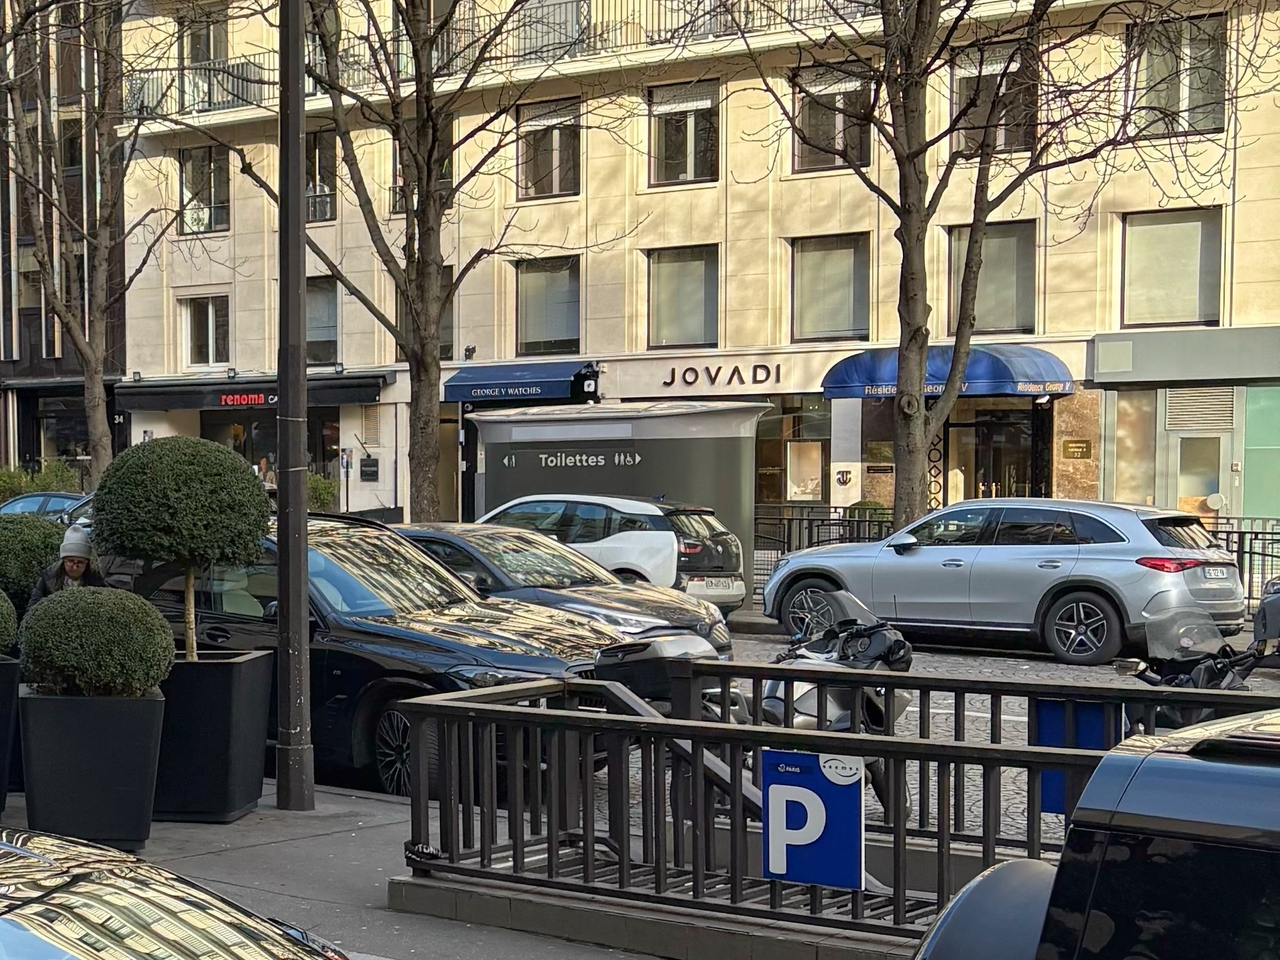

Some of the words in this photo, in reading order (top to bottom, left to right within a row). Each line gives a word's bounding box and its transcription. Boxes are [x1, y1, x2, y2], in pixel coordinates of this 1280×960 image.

[663, 363, 782, 387] JOVADI
[472, 387, 499, 396] GEORGE
[507, 386, 541, 395] WATCHES
[864, 385, 897, 395] Réside
[961, 383, 968, 391] V
[221, 394, 265, 405] renoma
[114, 414, 124, 424] 34
[539, 453, 605, 467] Toilettes
[768, 783, 827, 875] P
